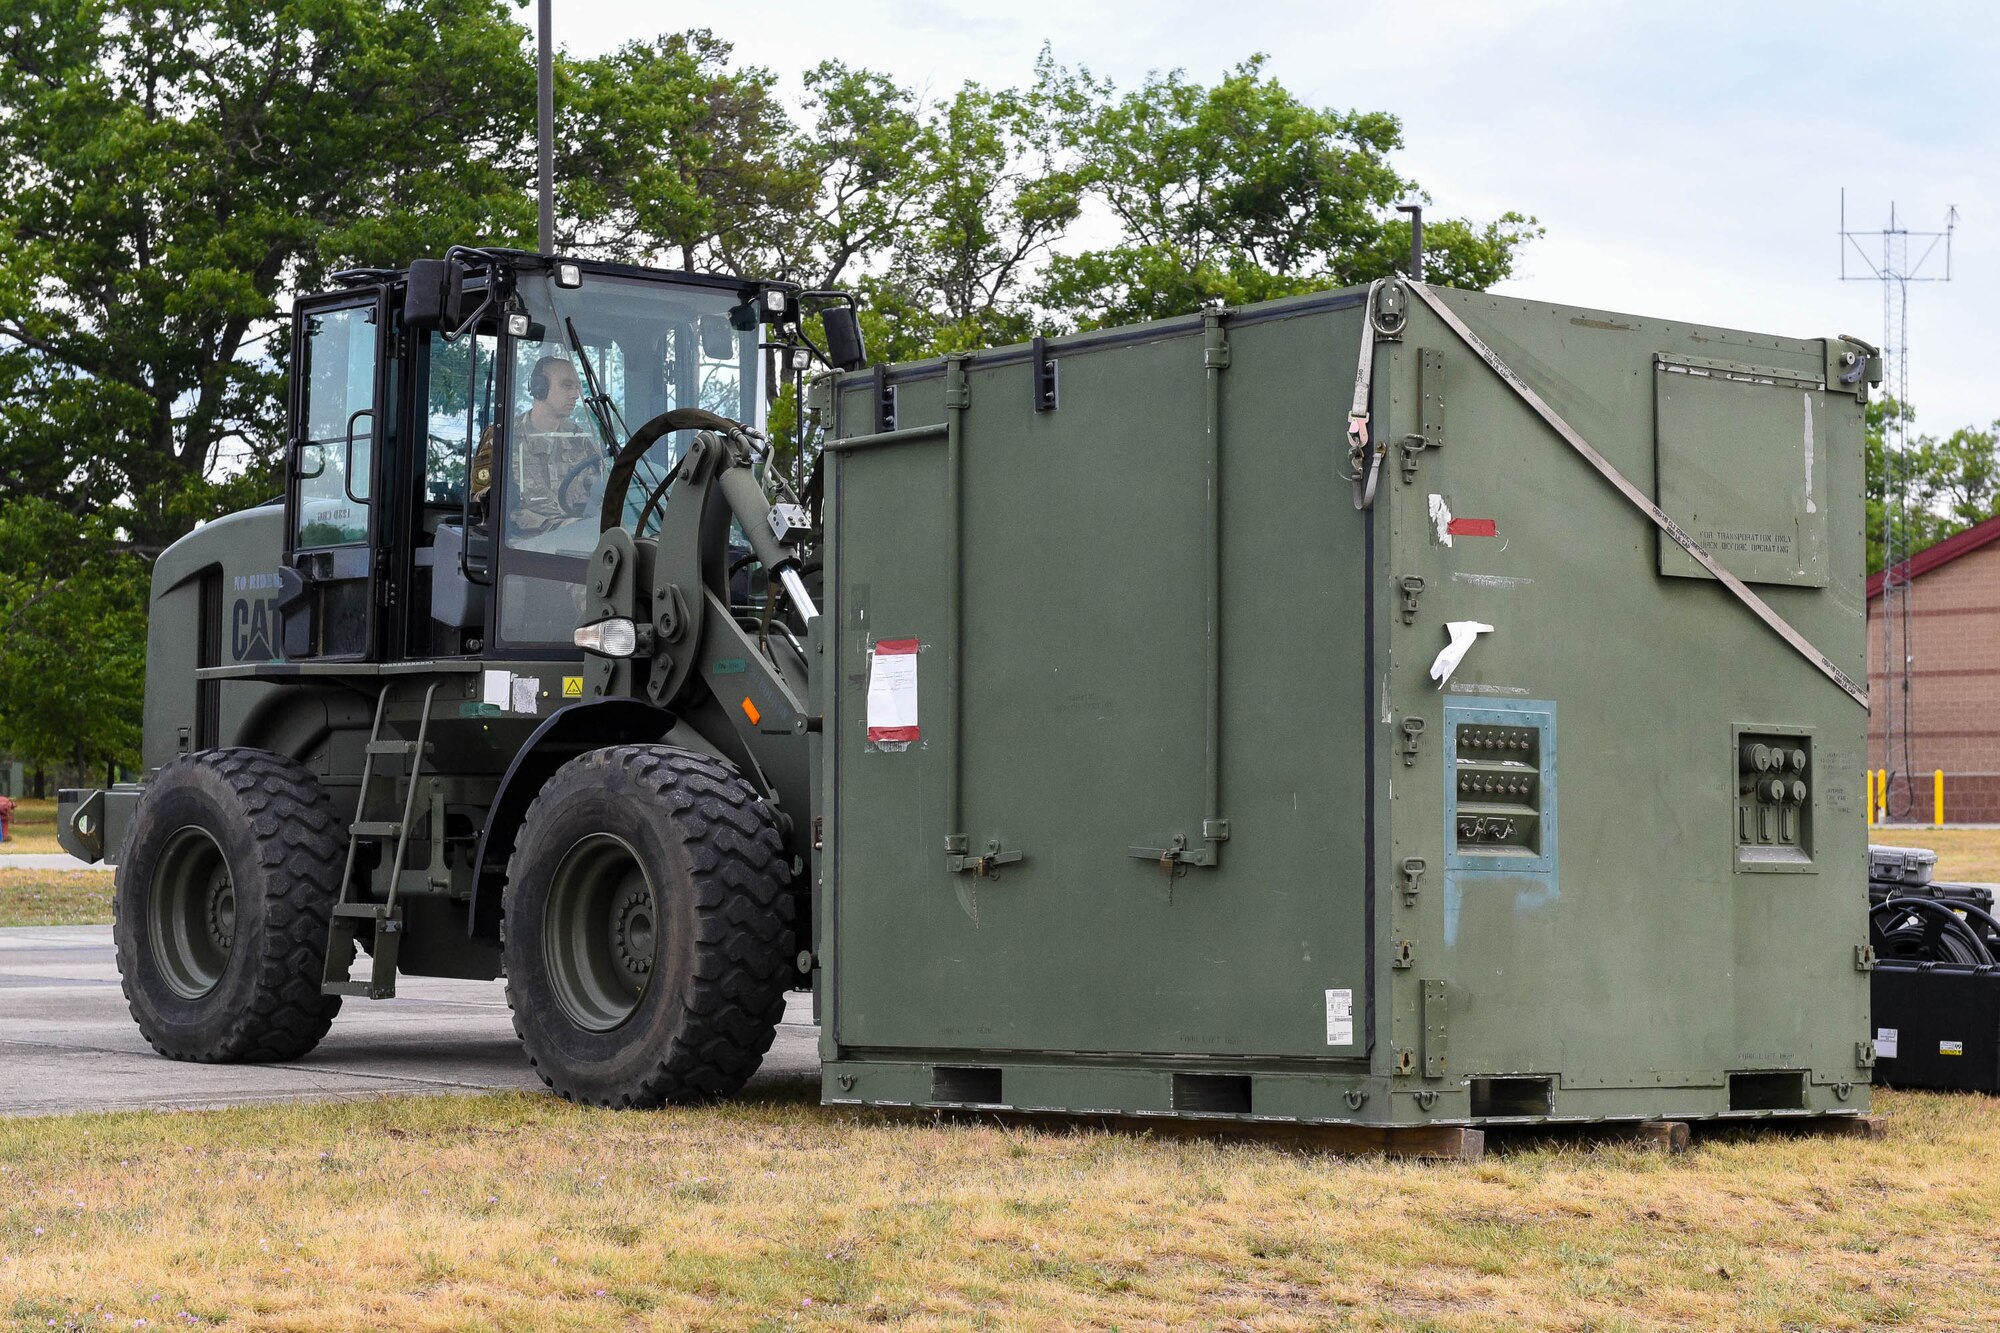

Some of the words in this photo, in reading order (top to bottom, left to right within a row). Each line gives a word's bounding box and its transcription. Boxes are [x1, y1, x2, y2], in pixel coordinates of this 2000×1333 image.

[1699, 530, 1713, 539] FOR
[1774, 534, 1792, 544] ONLY
[1721, 542, 1747, 552] BEFORE
[1751, 544, 1789, 554] OPERATING
[234, 575, 247, 591] NO
[232, 598, 281, 661] CAT
